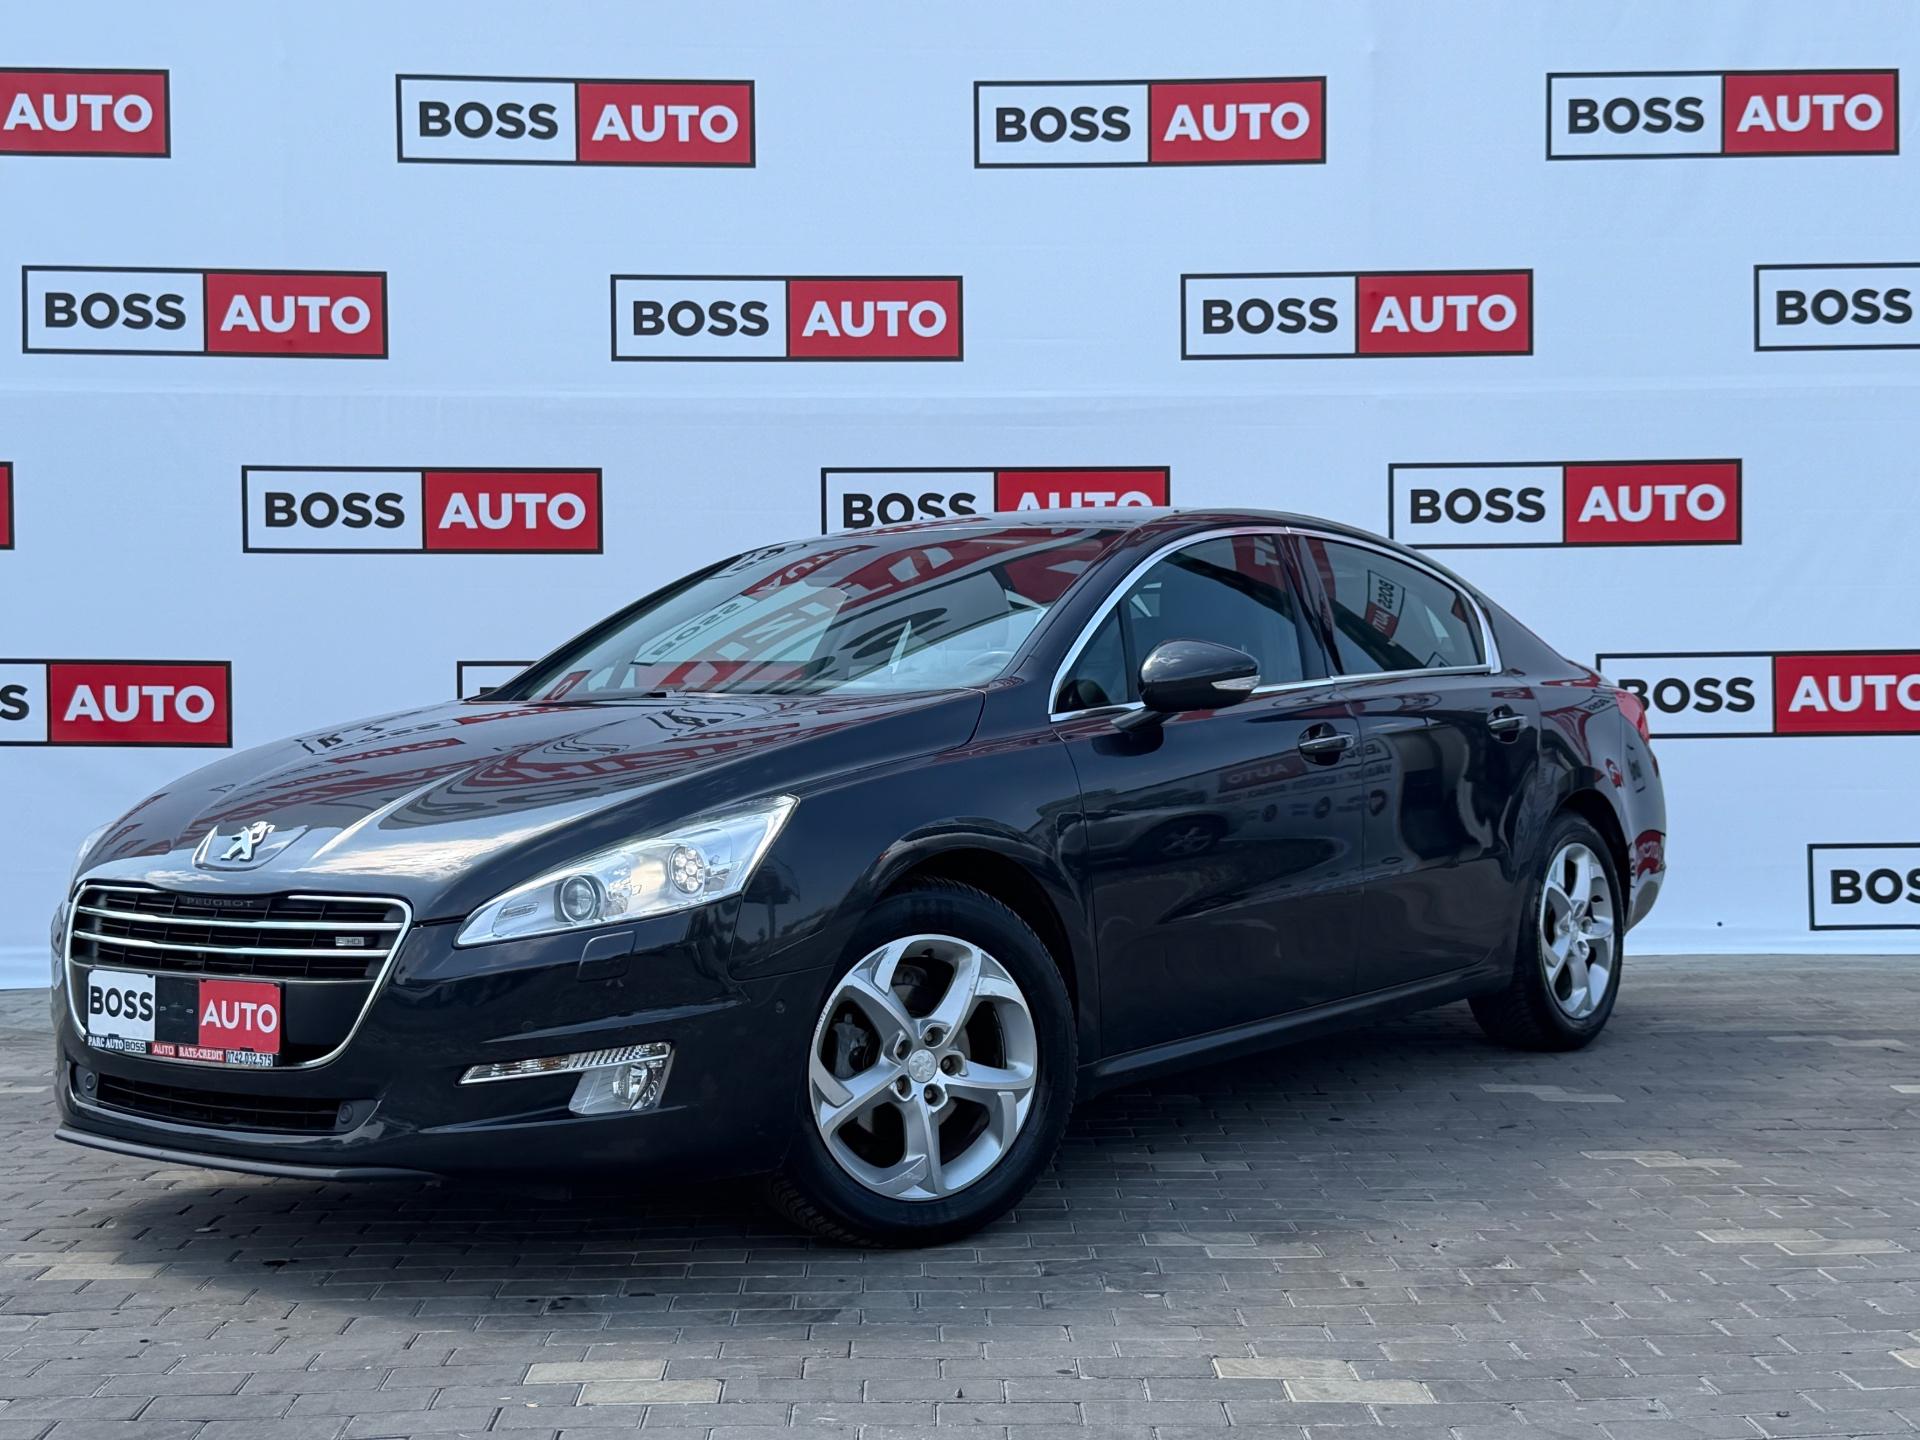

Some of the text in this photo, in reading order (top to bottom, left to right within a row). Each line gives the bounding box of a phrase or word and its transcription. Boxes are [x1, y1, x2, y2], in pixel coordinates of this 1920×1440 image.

[3, 93, 153, 133] AUTO
[419, 101, 739, 143] BOSS AUTO
[996, 102, 1310, 143] BOSS AUTO
[1568, 93, 1883, 134] BOSS AUTO
[45, 292, 371, 334] BOSS AUTO
[633, 300, 947, 338] BOSS AUTO
[1203, 294, 1517, 334] BOSS AUTO
[1776, 288, 1913, 325] BOSS
[265, 492, 586, 530] BOSS AUTO
[1410, 483, 1726, 524] BOSS AUTO
[63, 684, 215, 723] AUTO
[186, 897, 254, 908] PEUGEOT
[89, 986, 278, 1034] BOSS AUTO
[88, 1035, 105, 1048] PARC
[105, 1038, 124, 1050] AUTO
[125, 1041, 146, 1052] BOSS
[153, 1043, 175, 1055] AUTO
